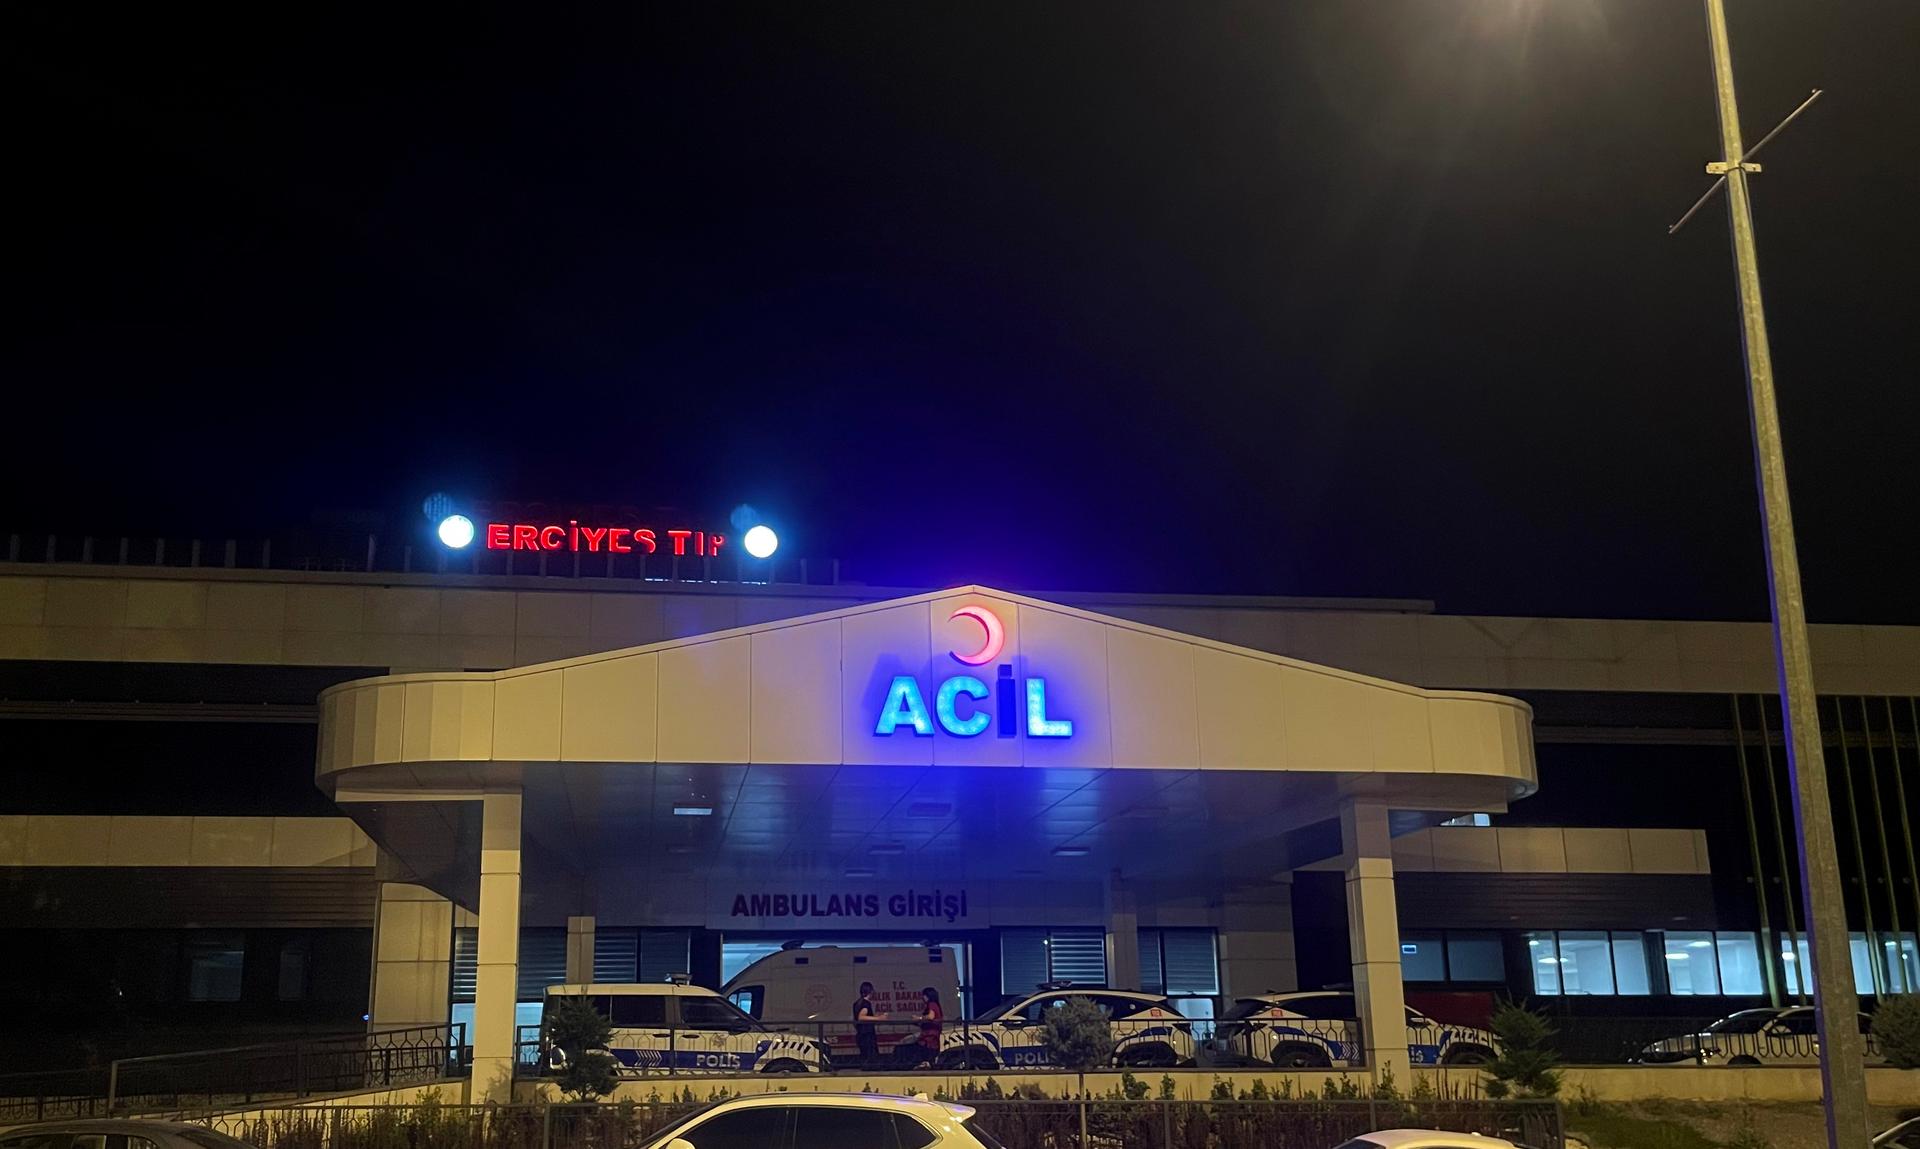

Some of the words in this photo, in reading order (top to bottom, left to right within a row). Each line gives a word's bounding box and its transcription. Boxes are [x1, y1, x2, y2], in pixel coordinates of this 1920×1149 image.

[488, 520, 656, 554] ERCİYES
[873, 664, 1073, 739] ACİL
[731, 893, 880, 917] AMBULANS
[888, 889, 968, 922] GİRİŞİ
[696, 1052, 741, 1068] POLİS
